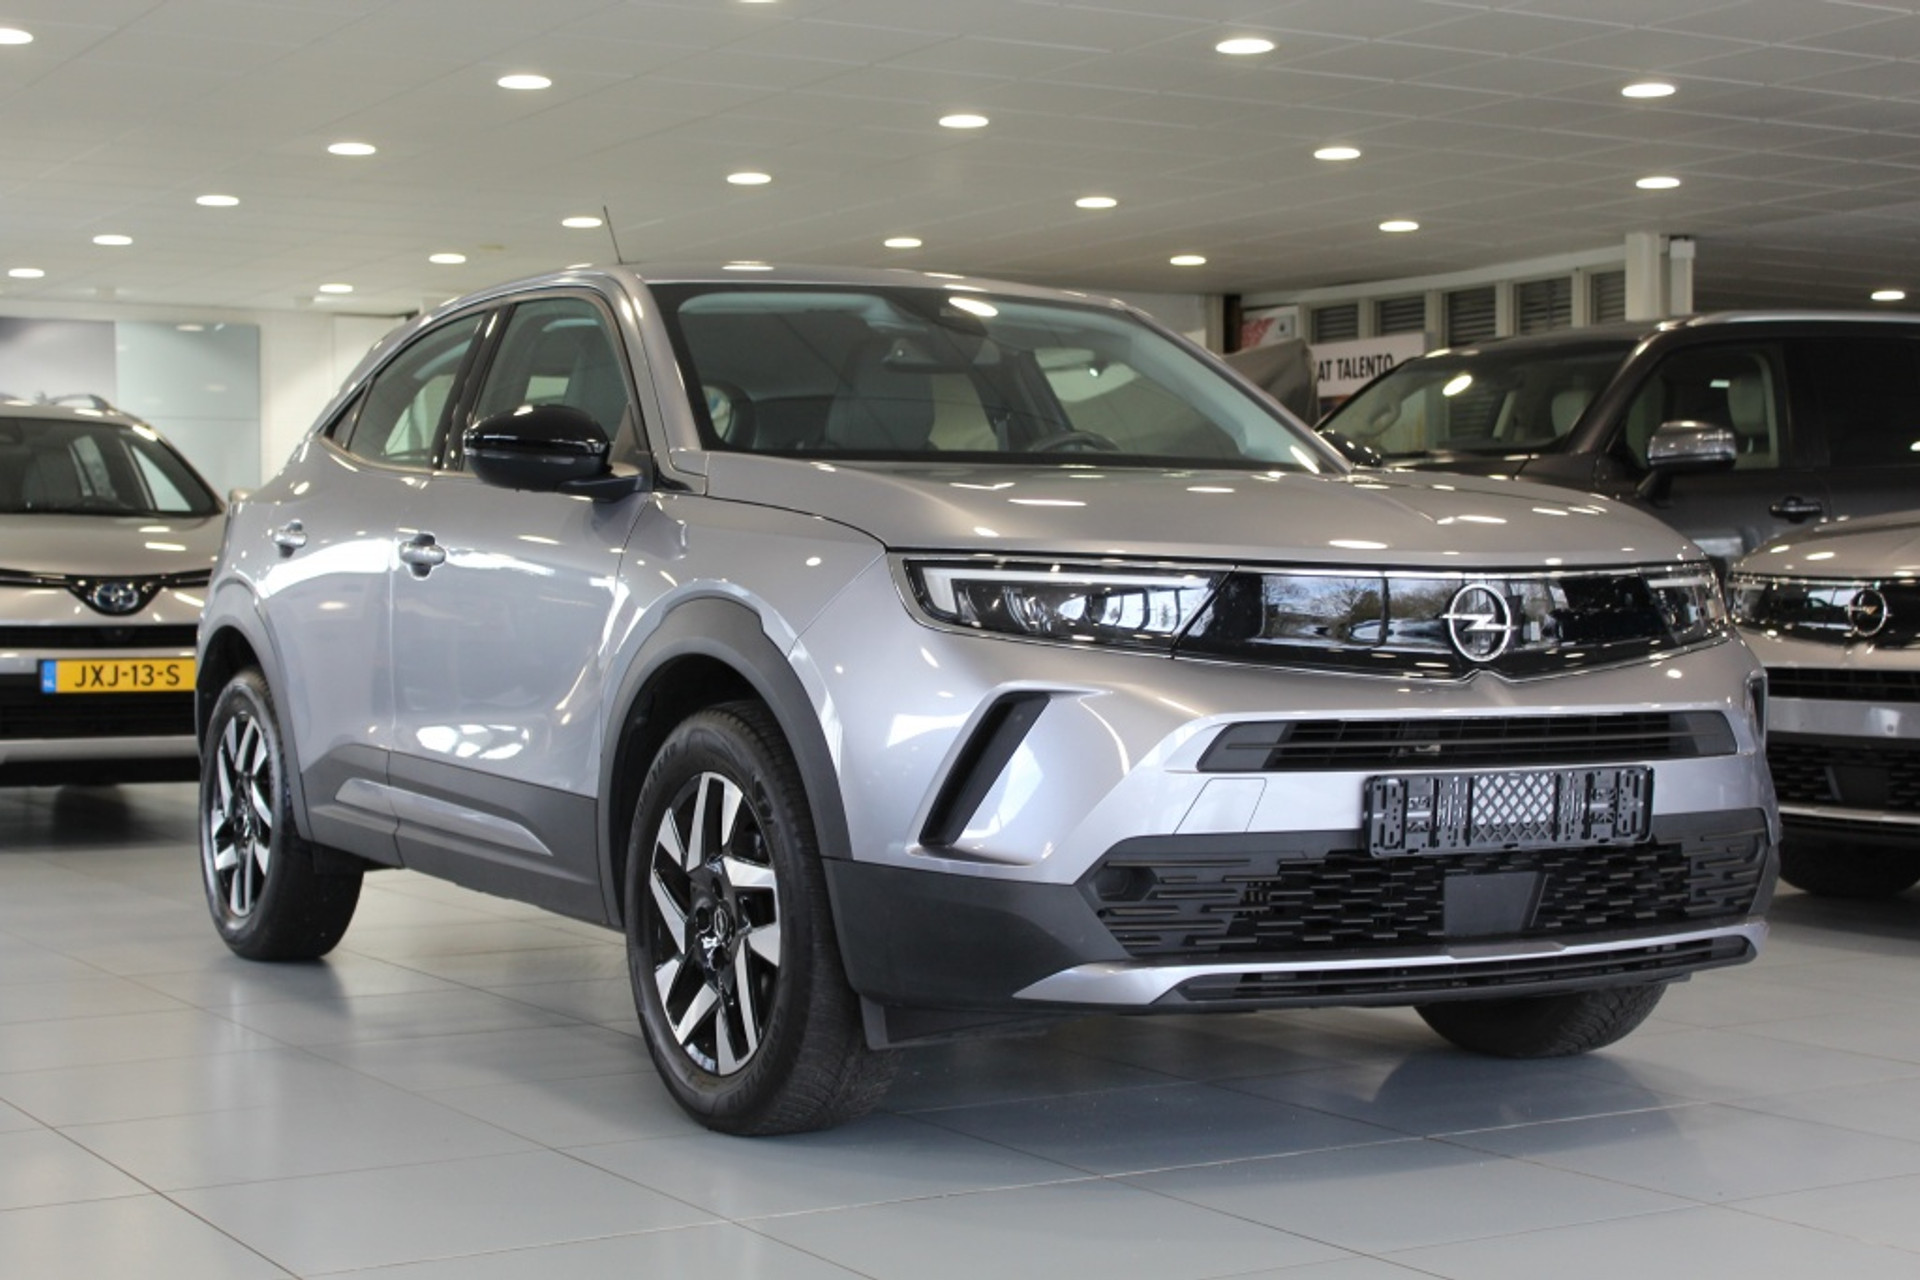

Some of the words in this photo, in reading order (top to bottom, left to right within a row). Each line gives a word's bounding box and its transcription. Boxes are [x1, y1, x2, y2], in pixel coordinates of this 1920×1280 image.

[1316, 359, 1332, 382] AT
[1337, 353, 1393, 380] TALENTO
[74, 664, 181, 687] JXJ-13-S
